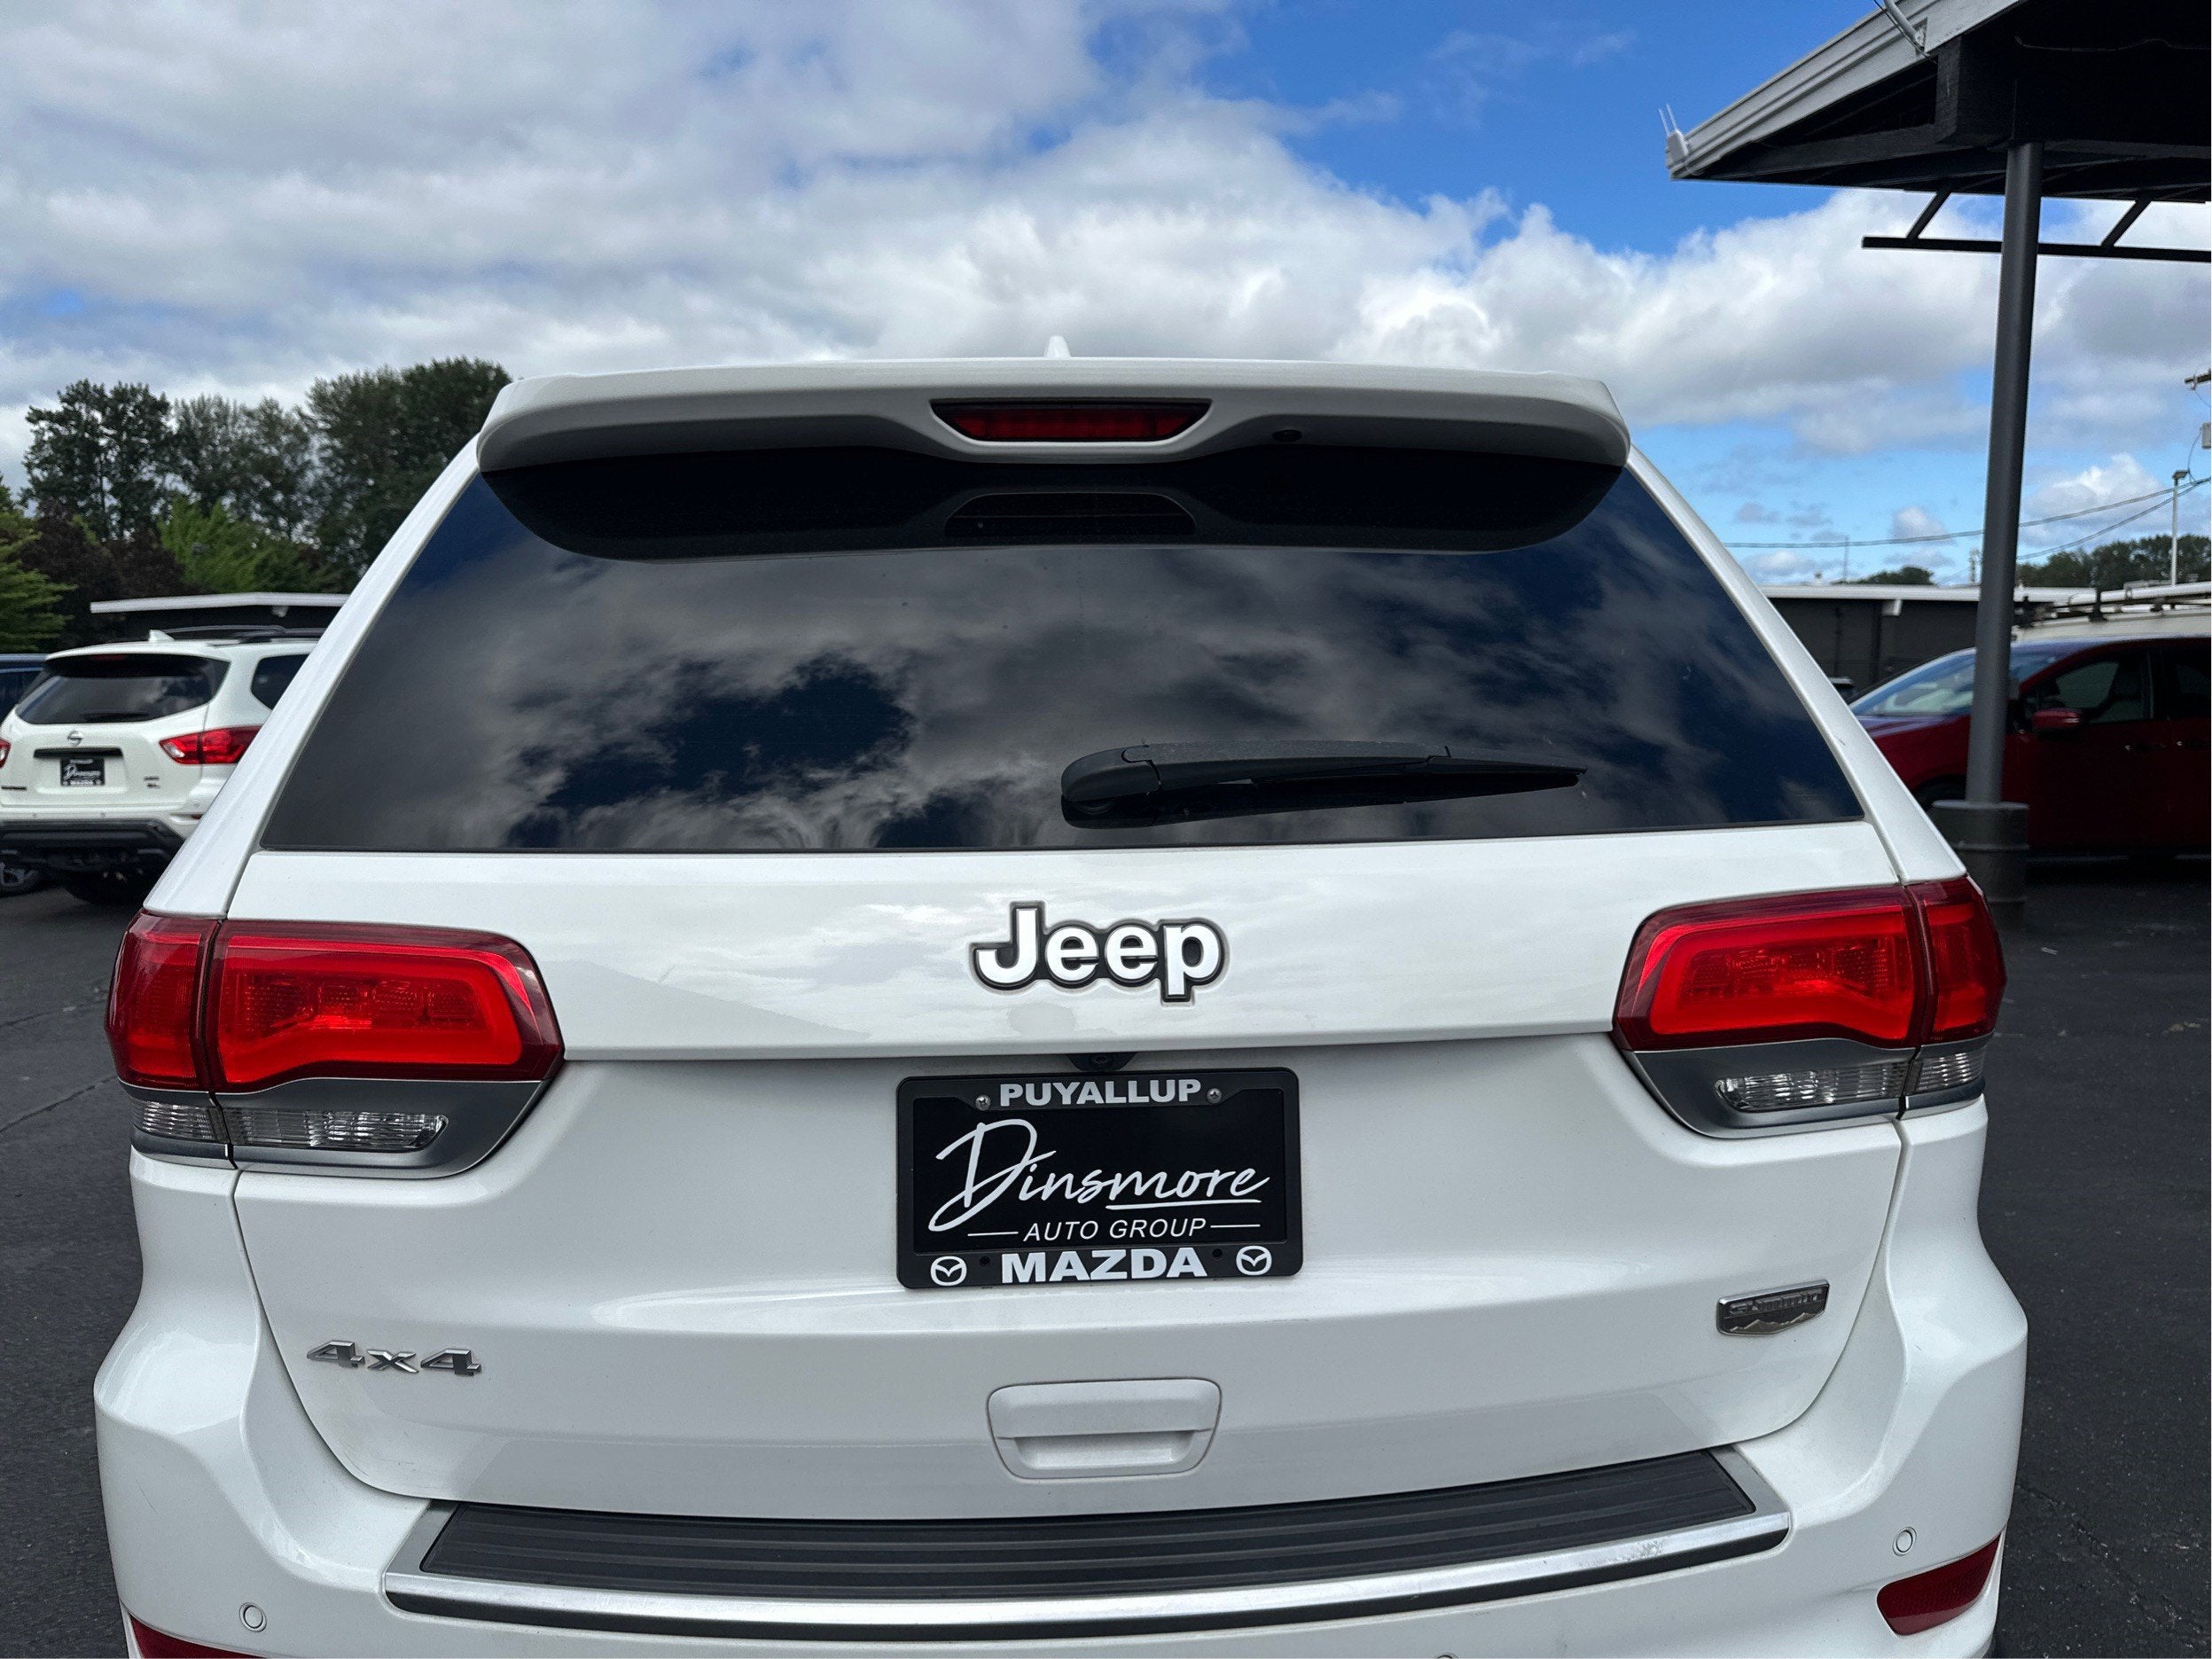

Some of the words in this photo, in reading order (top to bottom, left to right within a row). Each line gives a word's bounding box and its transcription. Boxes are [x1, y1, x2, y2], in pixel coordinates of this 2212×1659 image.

[973, 903, 1224, 1001] Jeep
[999, 1078, 1201, 1107] PUYALLUP
[927, 1118, 1270, 1232] Dinsmore
[1023, 1220, 1099, 1241] AUTO
[1109, 1217, 1208, 1239] GROUP
[1000, 1247, 1208, 1284] MAZDA
